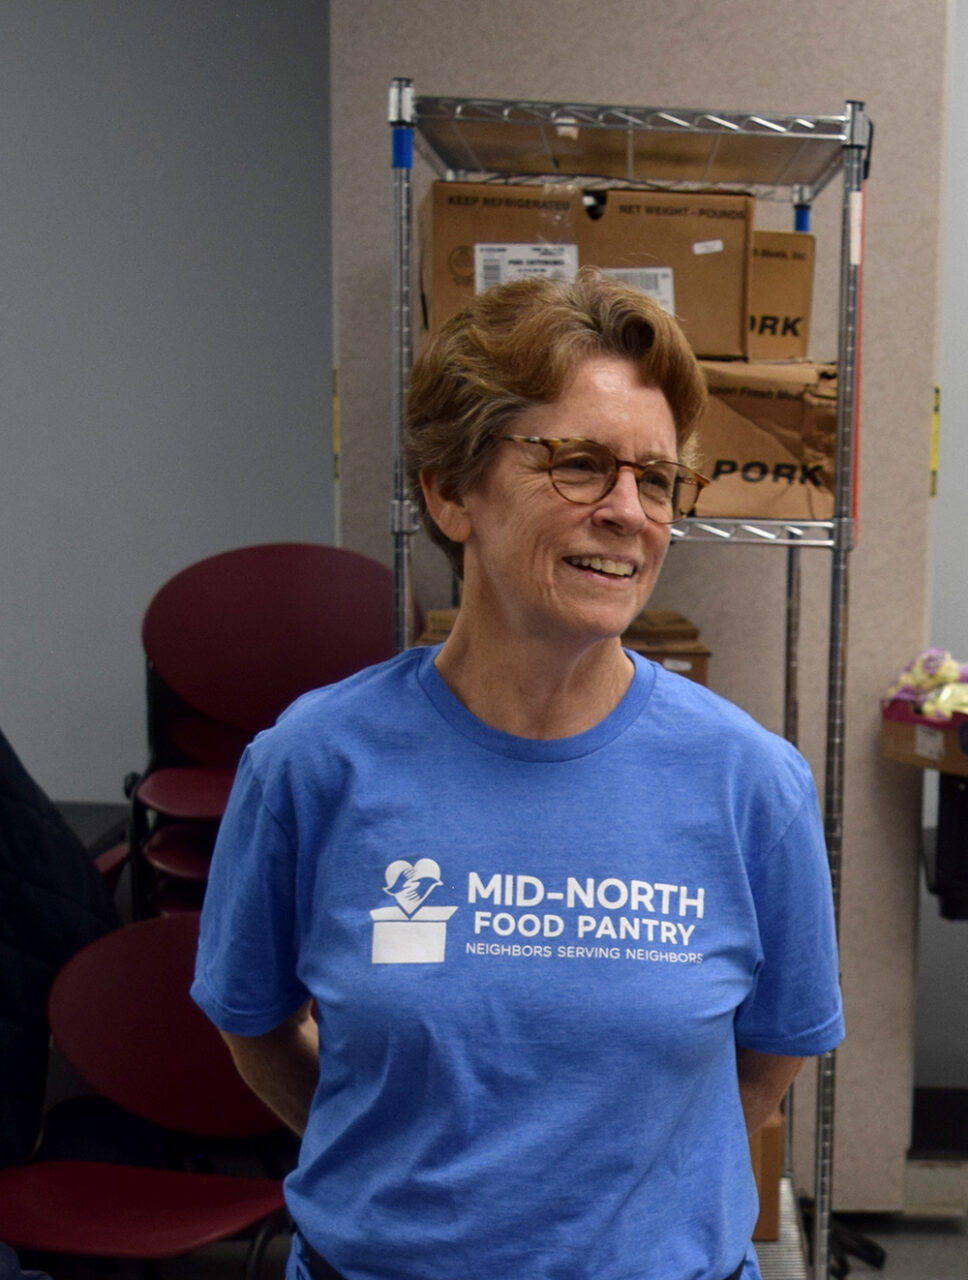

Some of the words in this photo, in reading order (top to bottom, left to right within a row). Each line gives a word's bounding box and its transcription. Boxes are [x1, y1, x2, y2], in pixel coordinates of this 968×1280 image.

[448, 196, 478, 206] KEEP
[481, 198, 571, 211] REFRIGERATED
[619, 203, 642, 214] NET
[645, 205, 688, 217] WEIGHT
[698, 208, 747, 219] POUNDS
[711, 459, 823, 487] PORK
[467, 871, 706, 919] MID-NORTH
[473, 910, 565, 938] FOOD
[576, 916, 696, 947] PANTRY
[465, 942, 553, 958] NEIGHBORS
[557, 945, 621, 960] SERVING
[626, 946, 705, 965] NEIGHBORS
